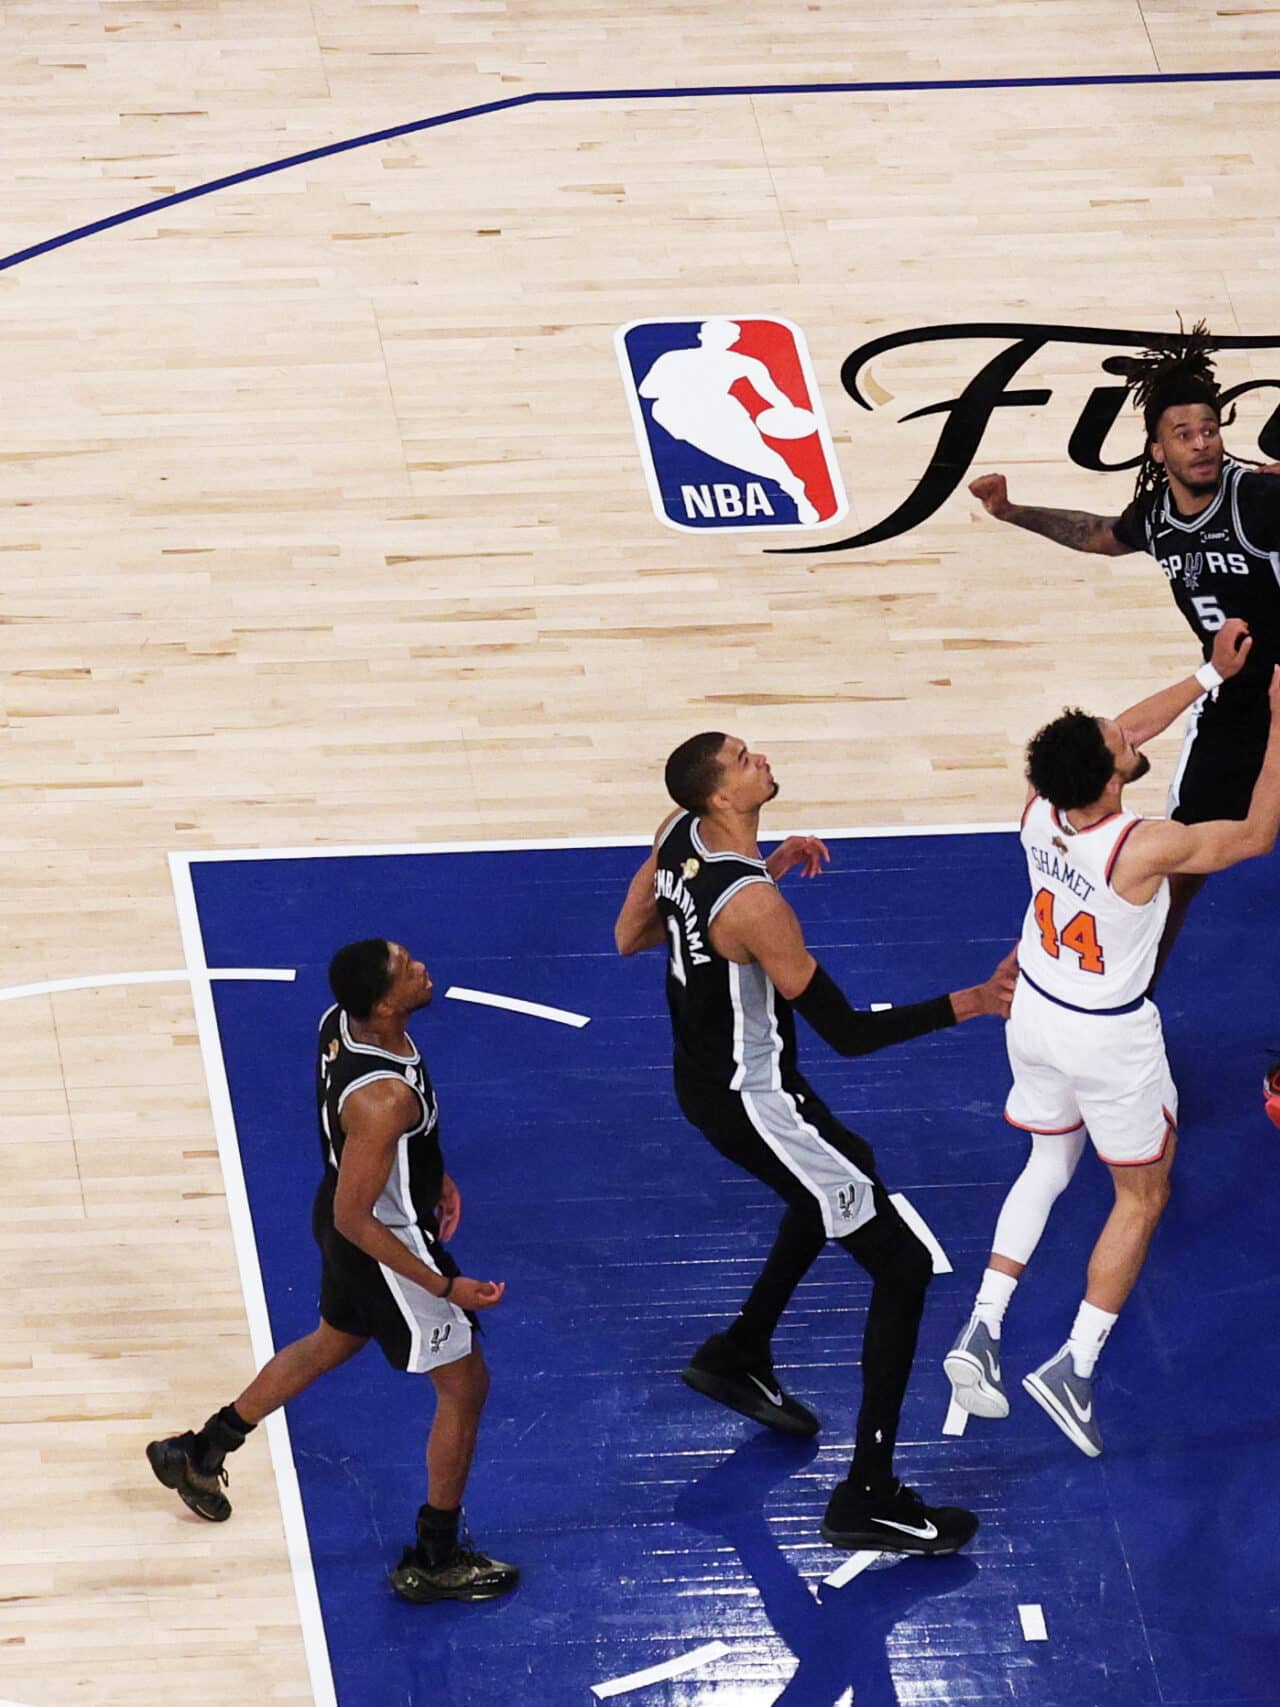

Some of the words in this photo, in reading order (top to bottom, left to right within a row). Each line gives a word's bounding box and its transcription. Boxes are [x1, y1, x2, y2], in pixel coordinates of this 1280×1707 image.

[680, 482, 775, 519] NBA
[1191, 596, 1227, 631] 5
[1031, 846, 1096, 902] SHAMET
[1034, 887, 1105, 975] 44
